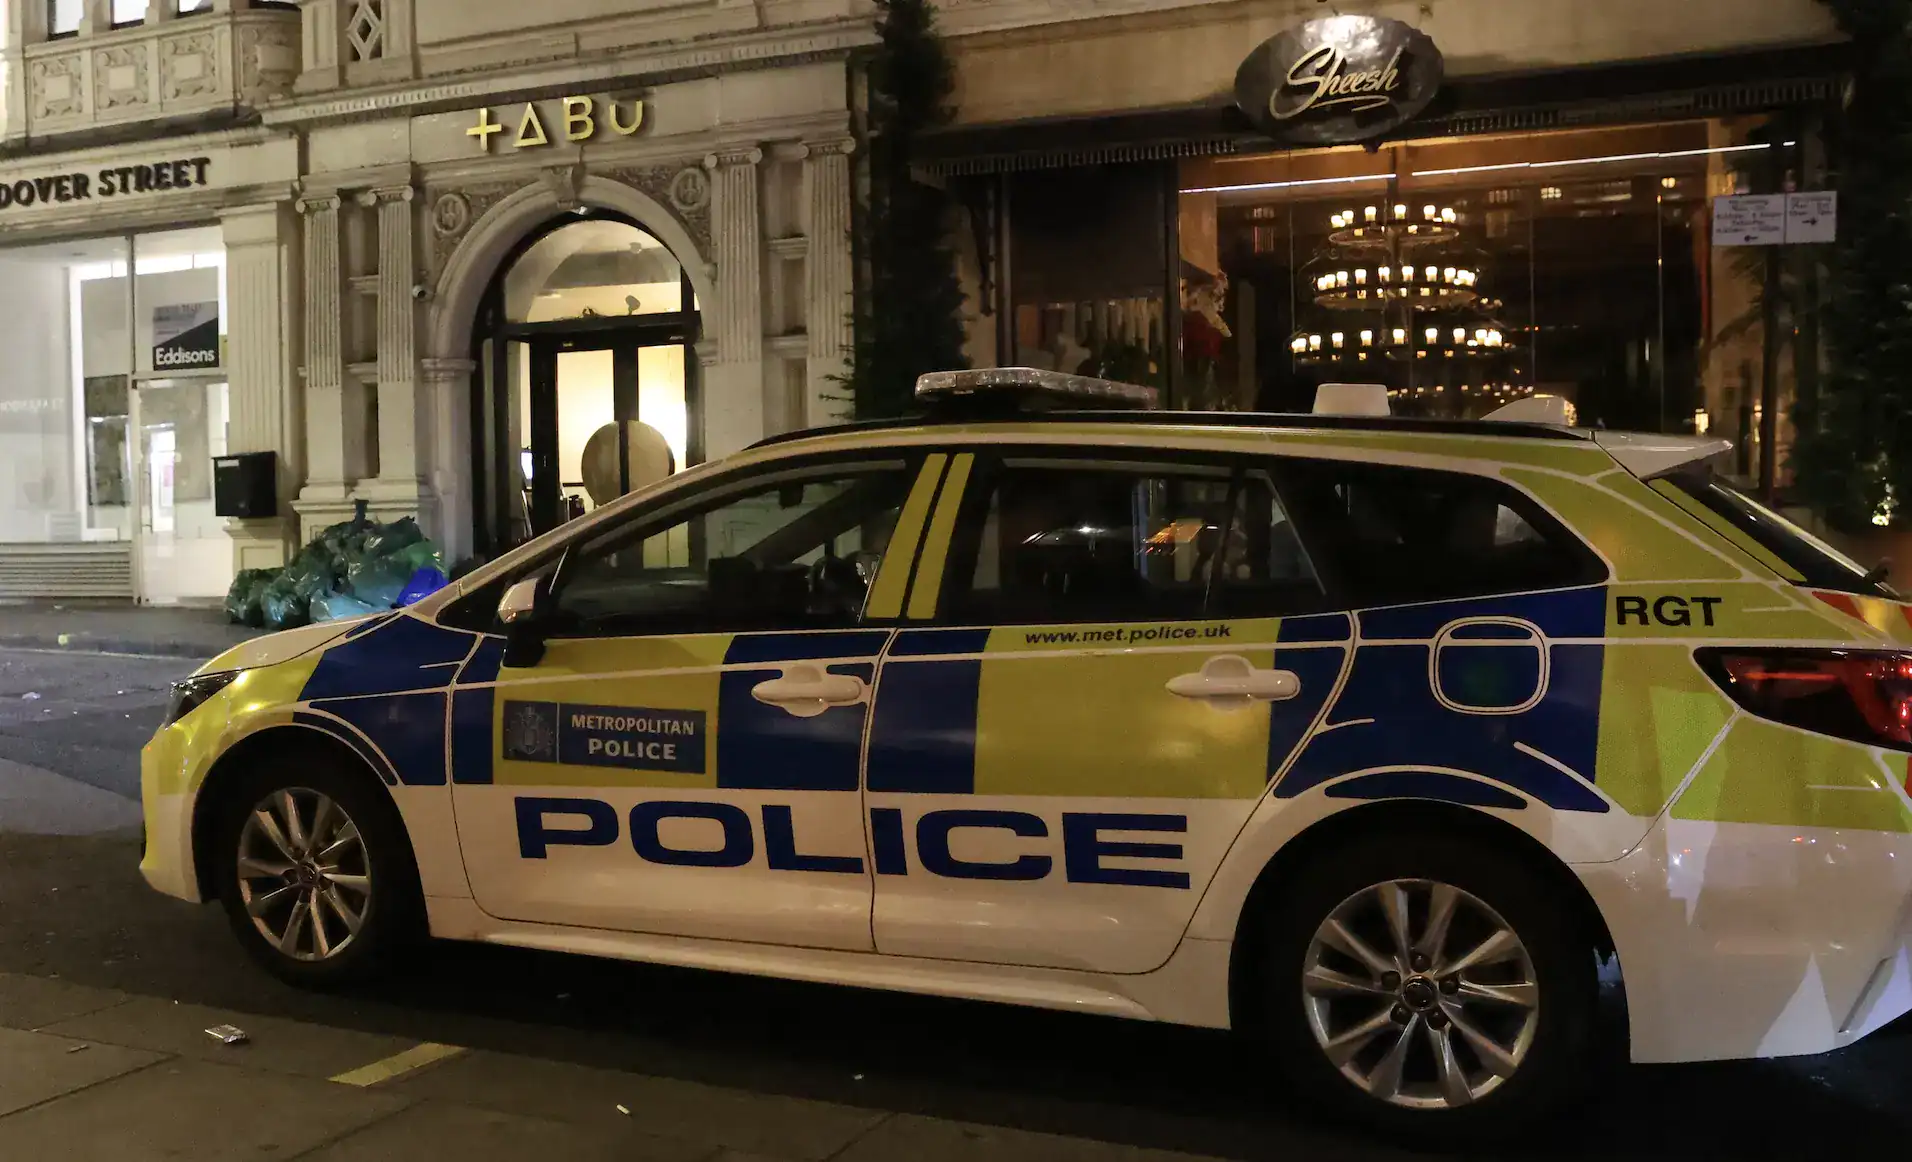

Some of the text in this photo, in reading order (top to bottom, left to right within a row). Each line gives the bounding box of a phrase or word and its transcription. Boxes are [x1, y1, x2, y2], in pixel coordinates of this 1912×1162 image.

[1269, 43, 1408, 120] Sheesh
[98, 156, 211, 197] STREET
[155, 346, 215, 366] Eddisons
[1616, 595, 1722, 626] RGT
[1025, 624, 1231, 644] www.met.police.uk
[571, 714, 695, 736] METROPOLITAN
[588, 738, 677, 761] POLICE
[514, 796, 1190, 890] POLICE
